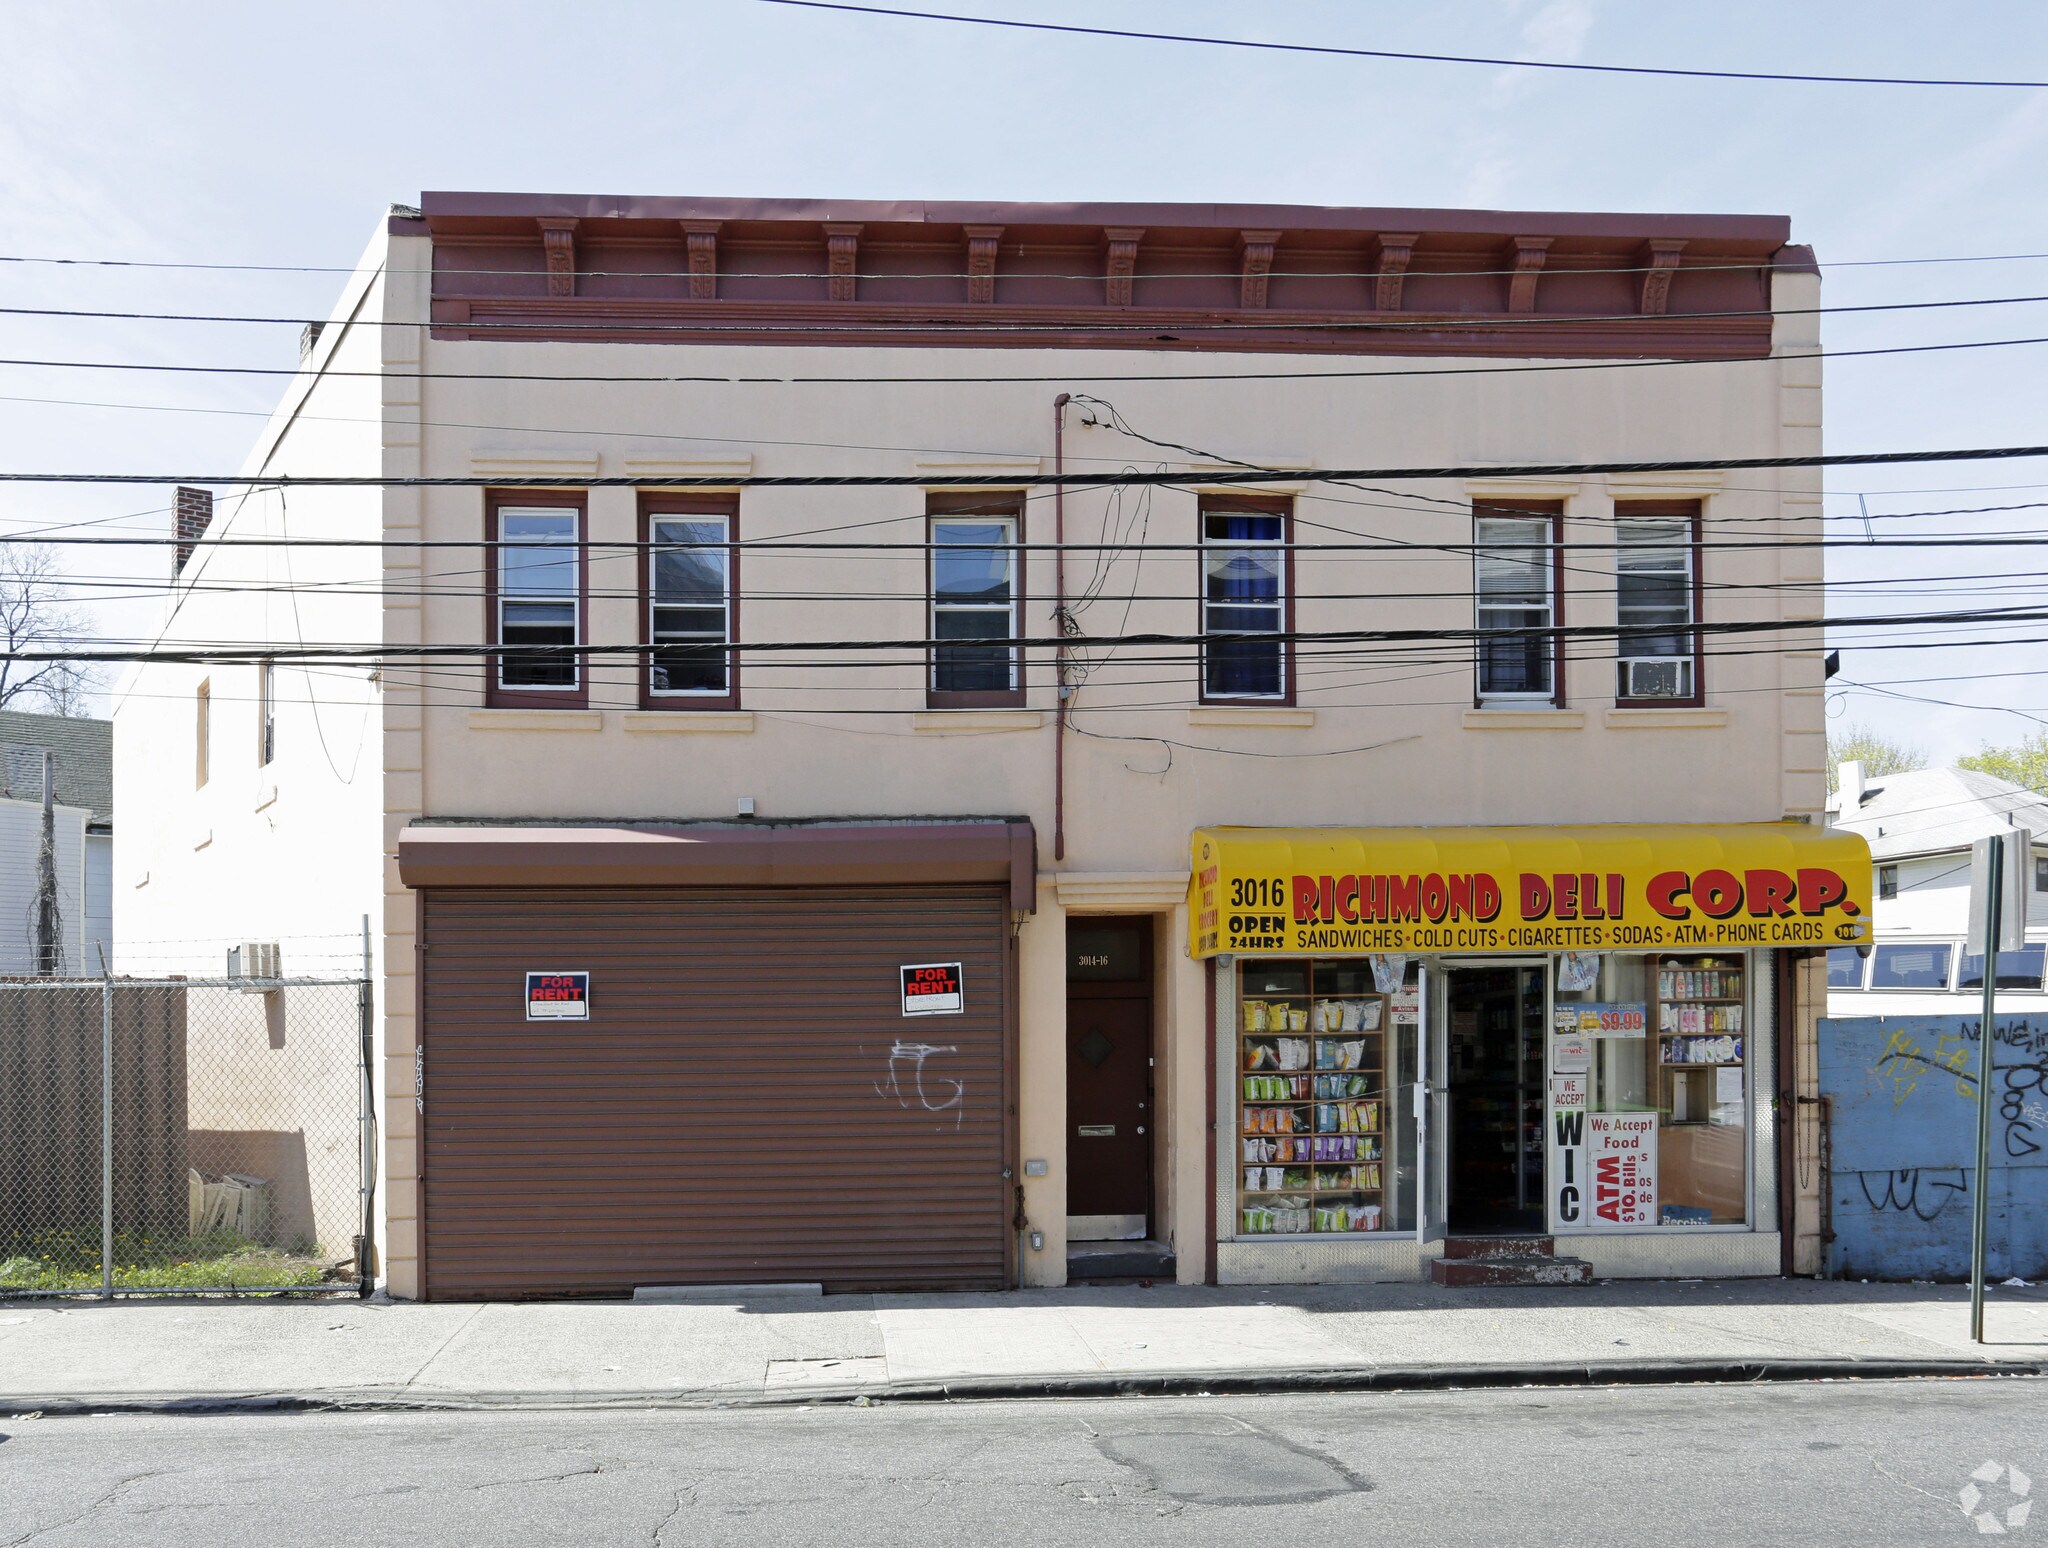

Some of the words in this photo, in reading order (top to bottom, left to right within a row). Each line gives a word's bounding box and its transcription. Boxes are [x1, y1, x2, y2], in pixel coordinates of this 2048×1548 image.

[1230, 878, 1284, 907] 3016
[1292, 872, 1501, 926] RICHMOND
[1519, 872, 1624, 921] DELI
[1646, 868, 1861, 920] CORP.
[1228, 915, 1285, 934] OPEN
[1229, 936, 1284, 949] 24HRS
[1297, 928, 1403, 948] SANDWICHES
[1413, 928, 1452, 947] COLD
[1458, 928, 1498, 947] CUTS
[1508, 926, 1602, 946] CIGARETTES
[1612, 925, 1663, 944] SODAS
[1674, 924, 1706, 943] ATM
[1717, 923, 1767, 942] PHONE
[1772, 923, 1823, 941] CARDS
[1078, 955, 1108, 966] 3014-16
[915, 968, 947, 981] FOR
[541, 977, 573, 987] FOR
[907, 980, 956, 995] RENT
[531, 988, 582, 1000] RENT
[1601, 1011, 1642, 1031] $9.99
[1564, 1081, 1575, 1091] WE
[1555, 1094, 1584, 1105] ACCEPT
[1591, 1119, 1609, 1131] We
[1614, 1119, 1653, 1133] Accept
[1604, 1136, 1639, 1149] Food
[1555, 1111, 1584, 1222] WIC
[1622, 1155, 1636, 1187] Bills
[1597, 1156, 1619, 1222] ATM
